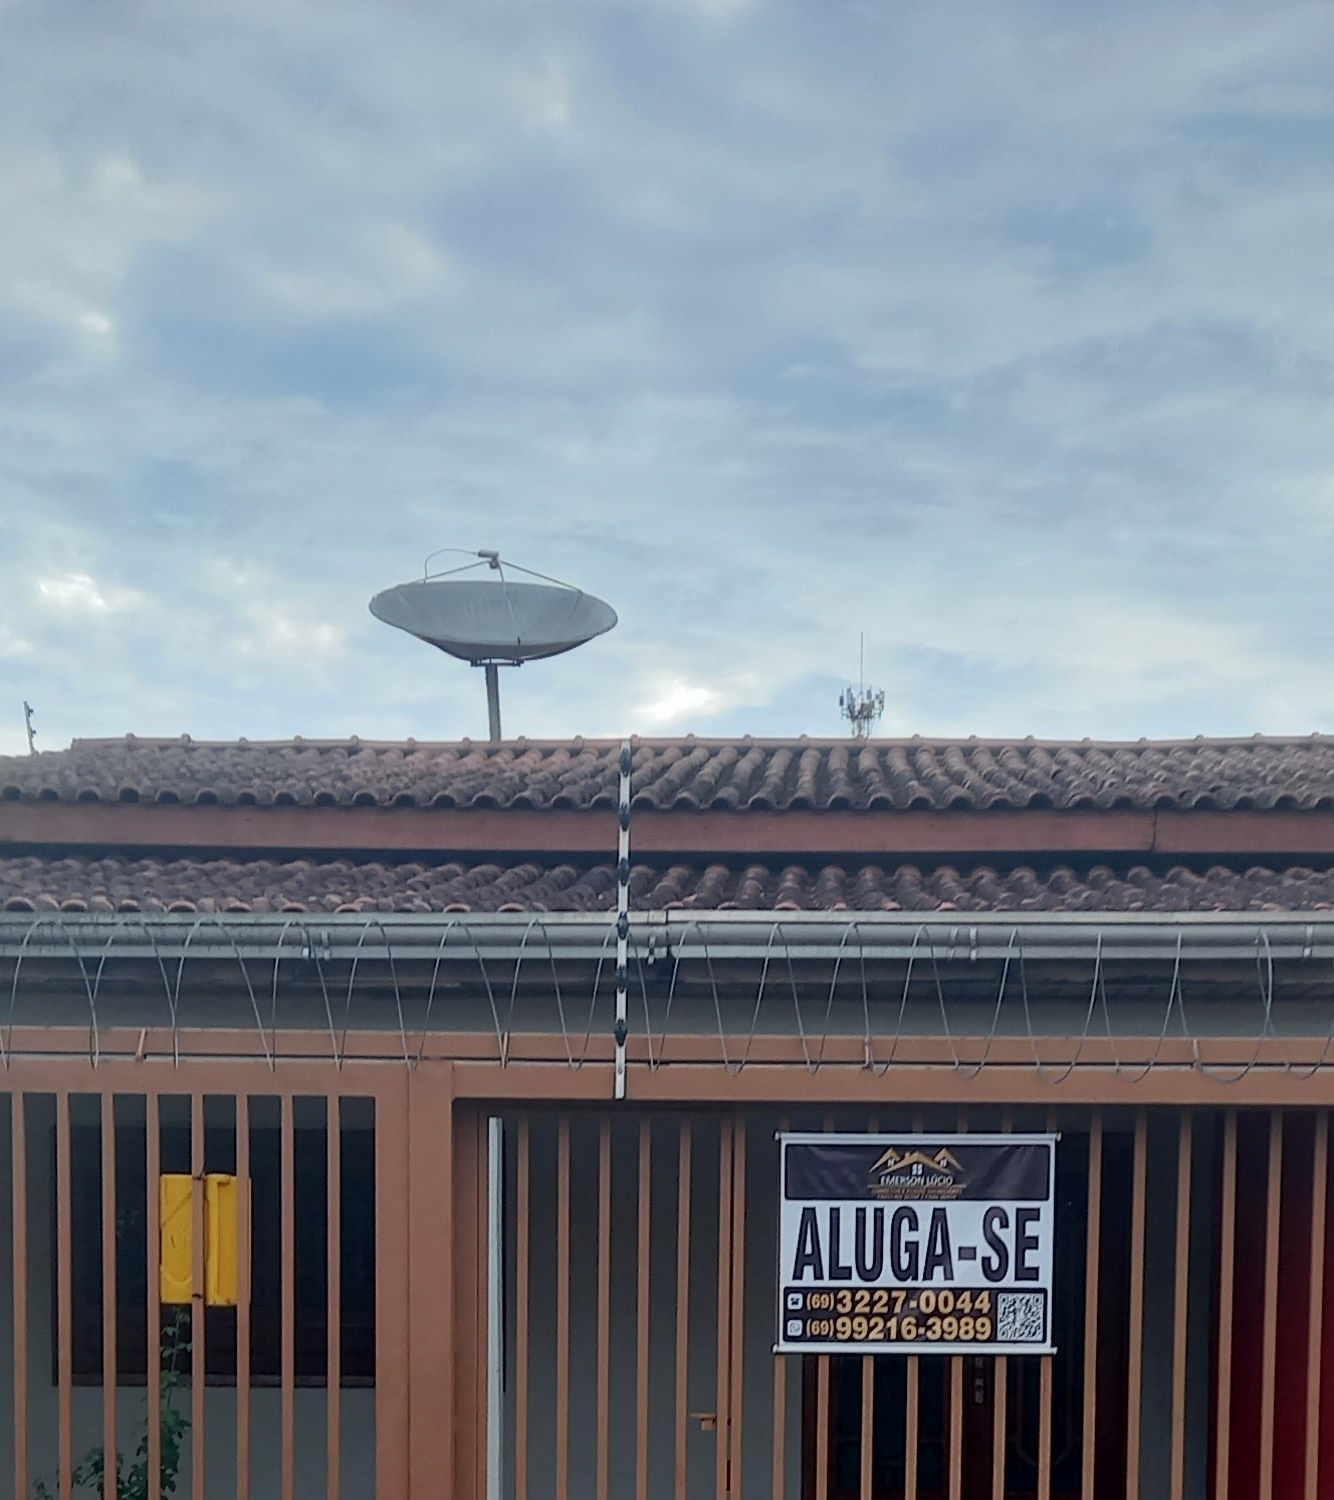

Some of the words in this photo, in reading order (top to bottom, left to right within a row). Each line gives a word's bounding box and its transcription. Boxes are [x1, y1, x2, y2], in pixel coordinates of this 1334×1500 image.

[880, 1175, 924, 1187] EMERSON
[926, 1174, 954, 1187] LÚCIO
[791, 1205, 1042, 1283] ALUGA-SE
